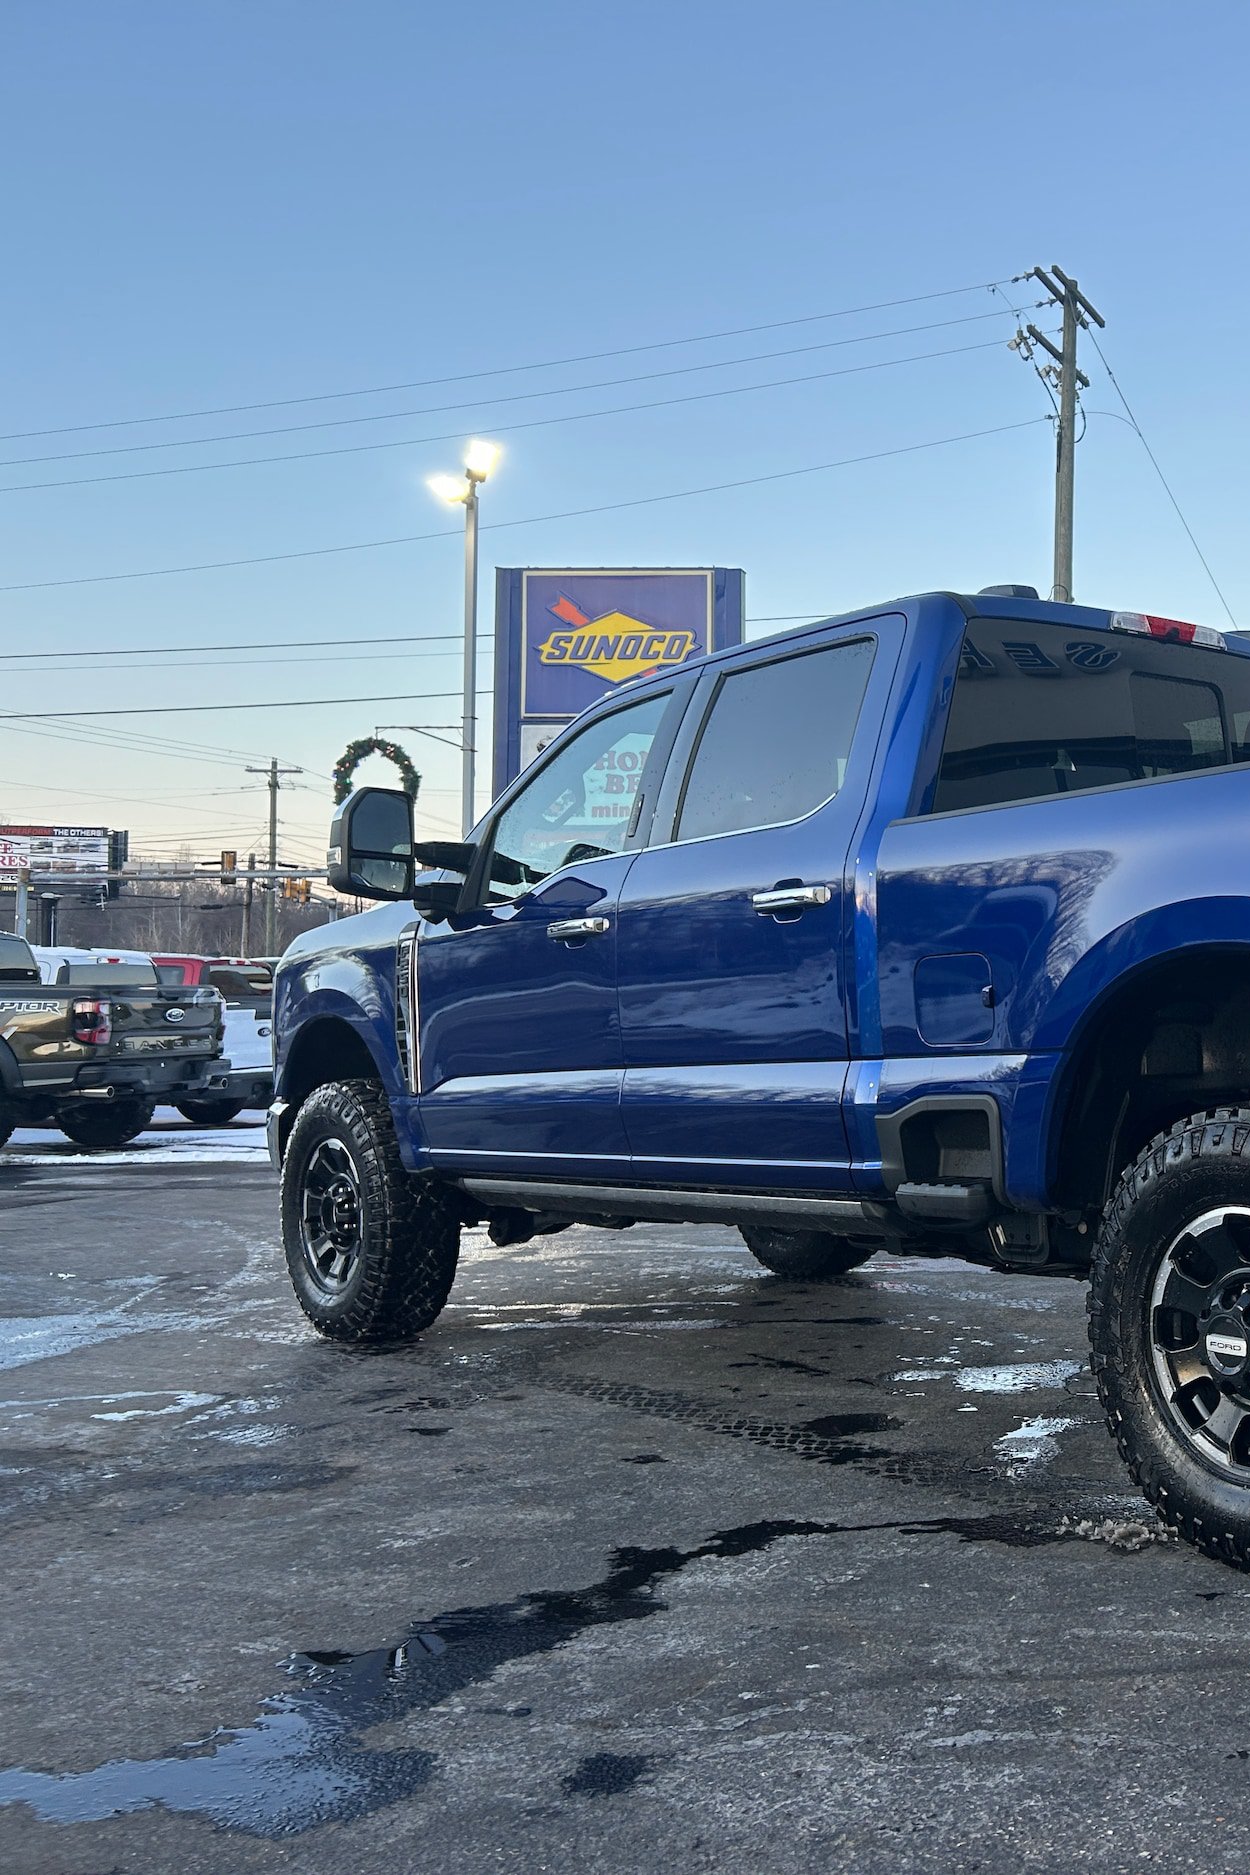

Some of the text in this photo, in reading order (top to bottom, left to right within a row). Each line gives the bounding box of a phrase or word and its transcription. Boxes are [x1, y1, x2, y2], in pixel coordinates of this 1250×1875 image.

[546, 635, 689, 661] SUNOCO
[0, 827, 104, 837] UTPERFORM THE OTHERS!
[1210, 1341, 1242, 1351] FORD
